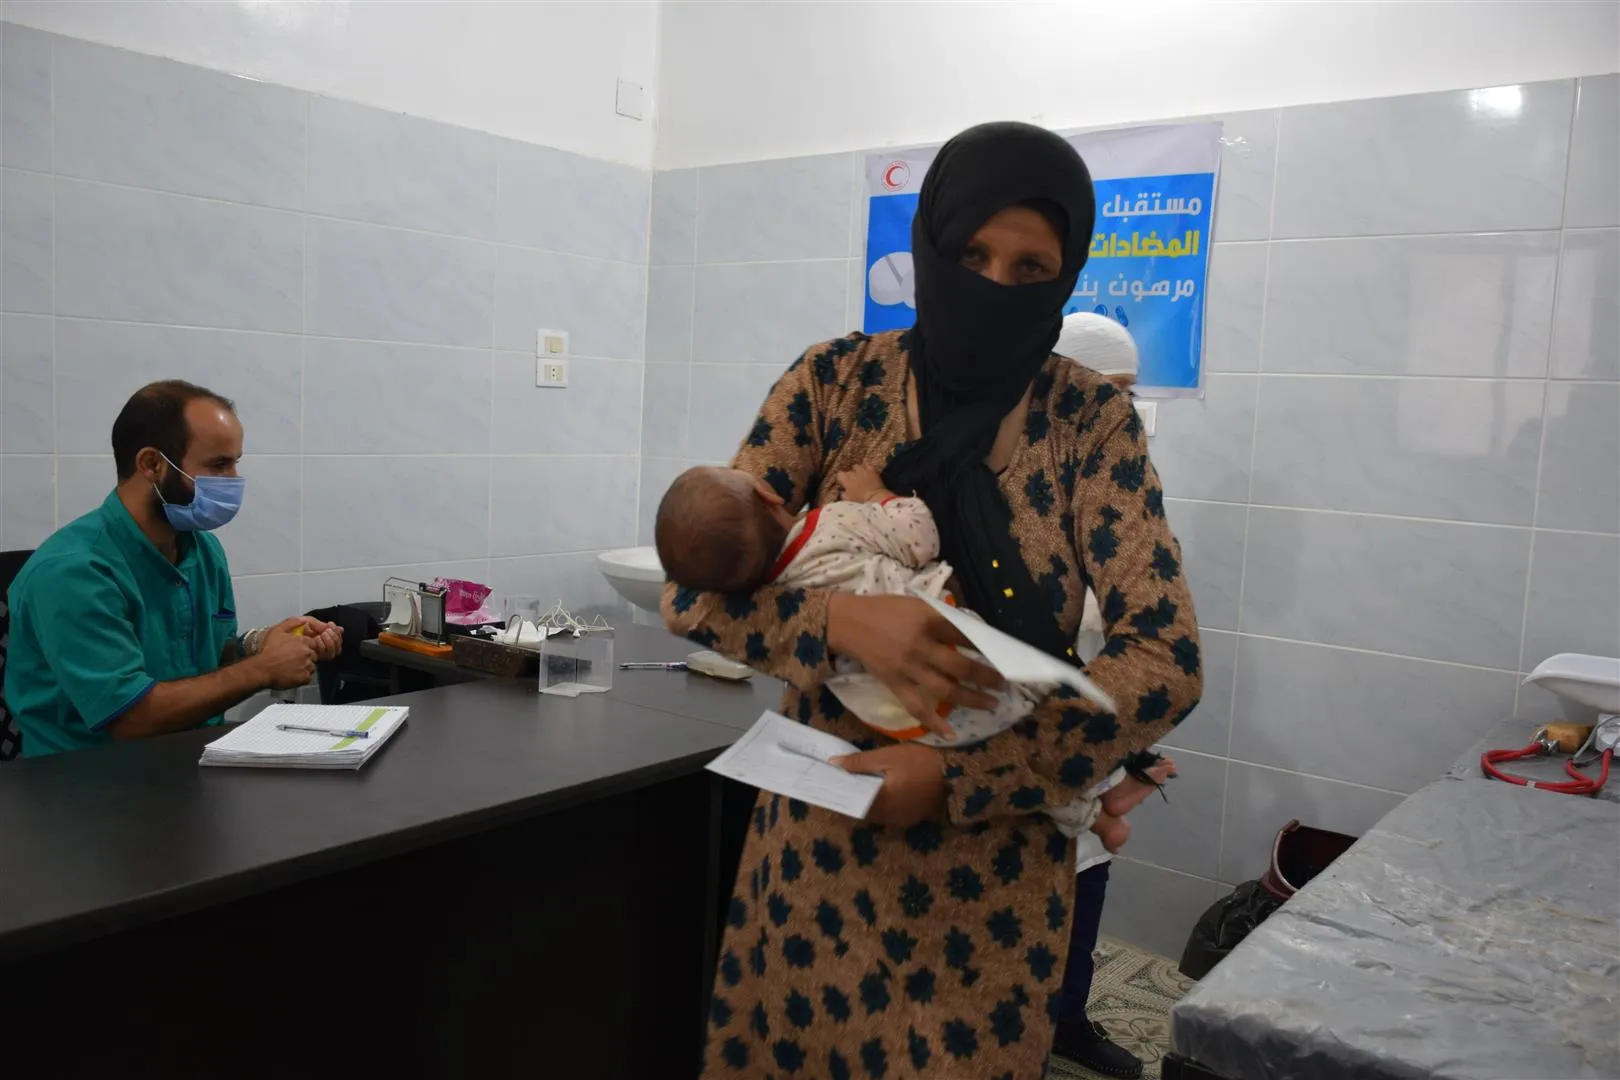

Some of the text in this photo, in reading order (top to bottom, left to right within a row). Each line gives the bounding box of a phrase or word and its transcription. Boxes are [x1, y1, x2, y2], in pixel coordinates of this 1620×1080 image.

[1102, 192, 1202, 223] مستقبل
[1088, 230, 1200, 259] المضادات
[1072, 273, 1195, 303] مرهون بن
